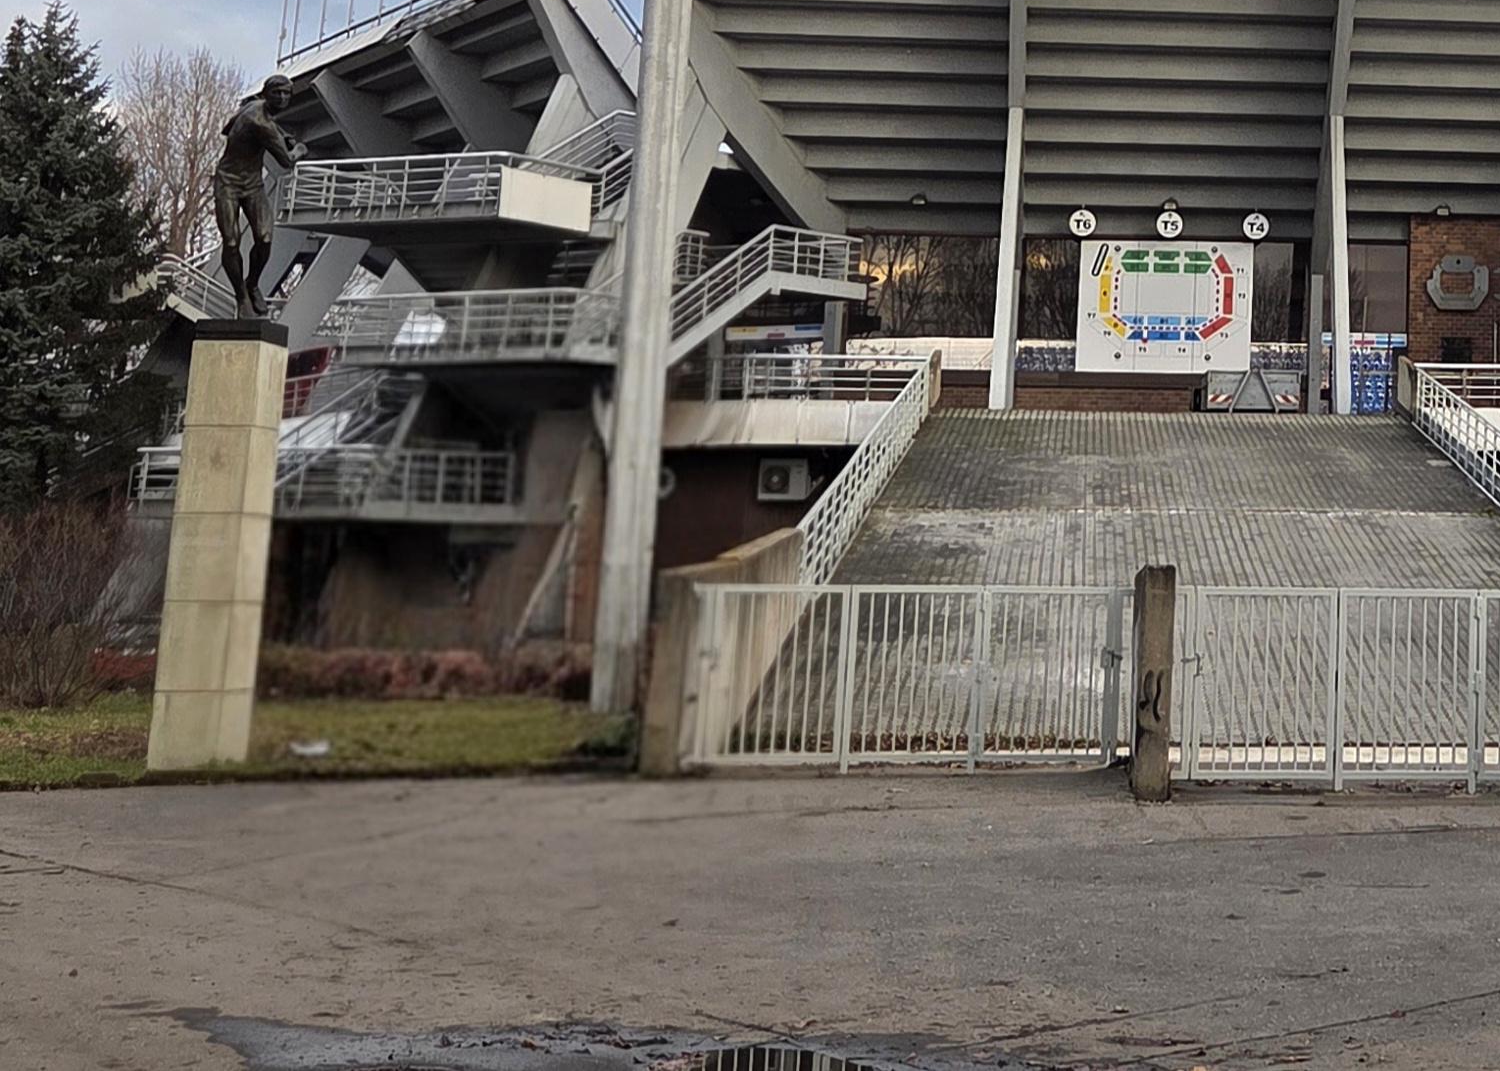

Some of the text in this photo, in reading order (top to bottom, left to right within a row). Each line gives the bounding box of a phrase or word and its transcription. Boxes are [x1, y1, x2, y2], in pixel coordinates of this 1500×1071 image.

[1074, 219, 1092, 230] T6
[1161, 220, 1179, 231] T5
[1247, 222, 1265, 233] T4
